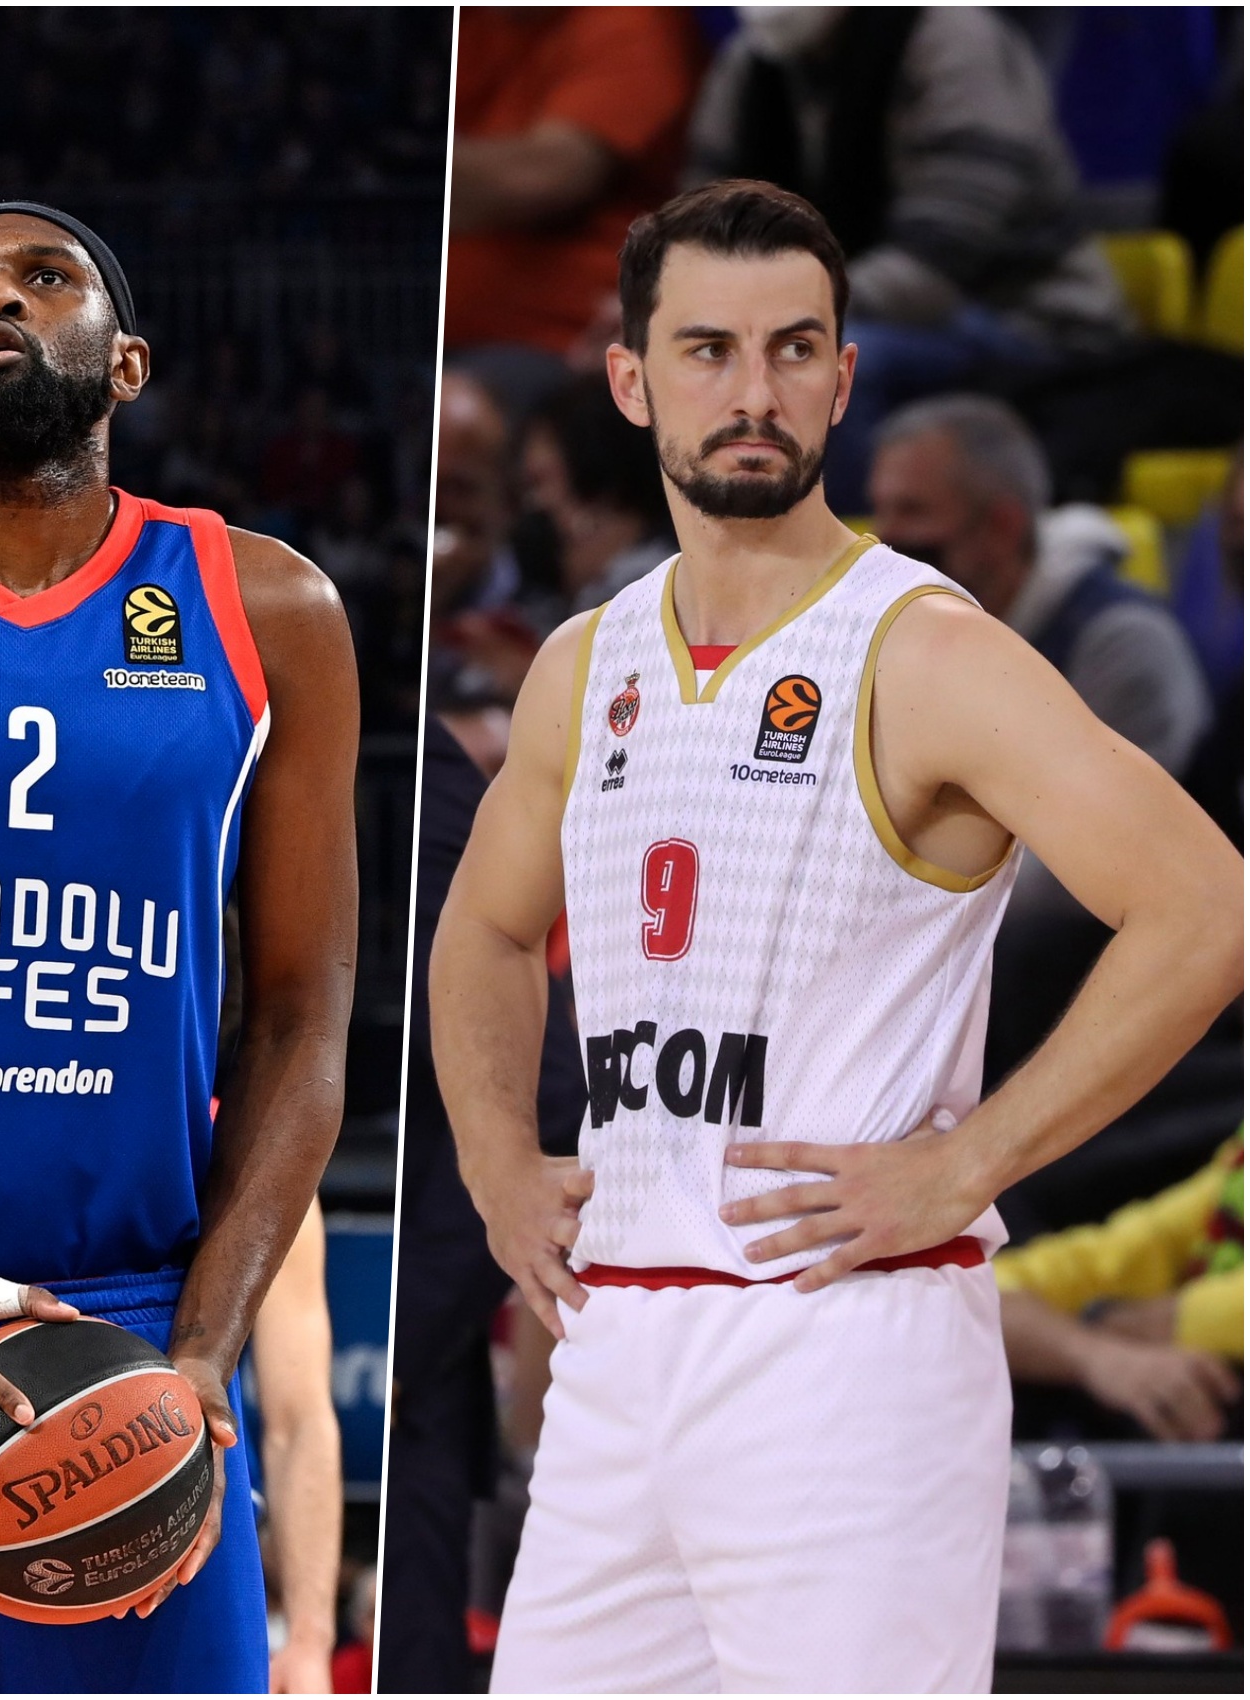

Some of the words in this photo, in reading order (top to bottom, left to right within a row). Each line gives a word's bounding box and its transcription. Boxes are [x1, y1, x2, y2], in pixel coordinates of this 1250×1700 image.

[130, 637, 176, 646] TURKISH
[130, 645, 177, 654] AIRLINES
[130, 653, 178, 662] EuroLeague
[764, 731, 807, 743] TURKISH
[761, 740, 805, 752] AIRLINES
[759, 749, 802, 760] EuroLeague
[8, 705, 57, 831] 2
[640, 837, 699, 962] 9
[1, 1390, 191, 1531] SPALDING
[81, 1524, 163, 1570] TURKISH
[167, 1464, 209, 1532] AIRLINES
[84, 1513, 196, 1587] EuroLeague
